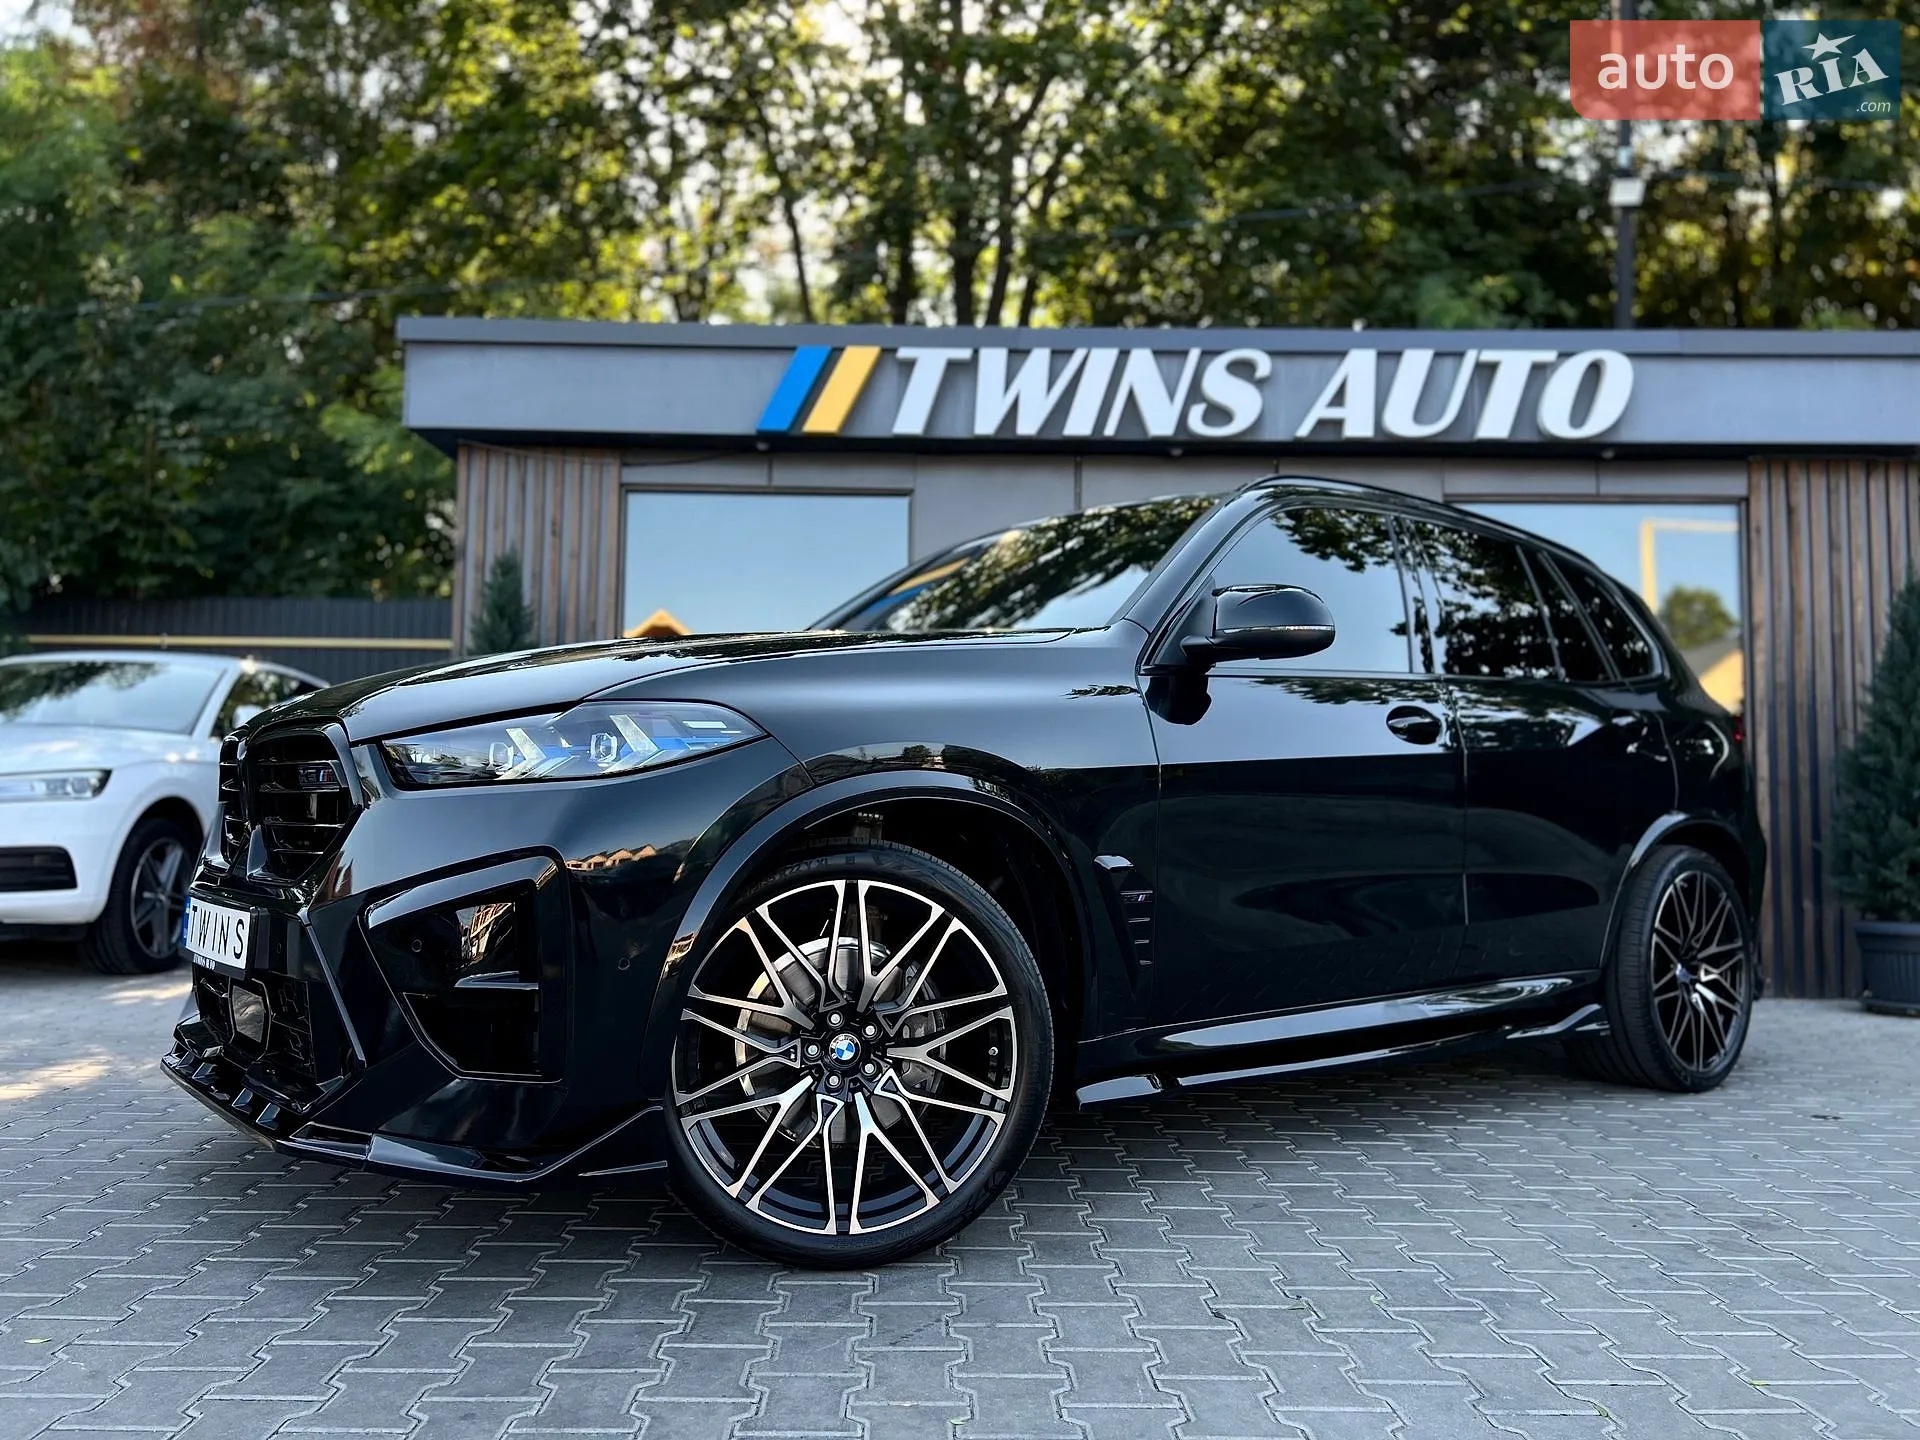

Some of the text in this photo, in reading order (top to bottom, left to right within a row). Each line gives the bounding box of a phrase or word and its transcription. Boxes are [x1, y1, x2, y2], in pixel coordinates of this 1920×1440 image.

[892, 346, 1635, 440] TWINS AUTO
[190, 905, 246, 960] TWINS
